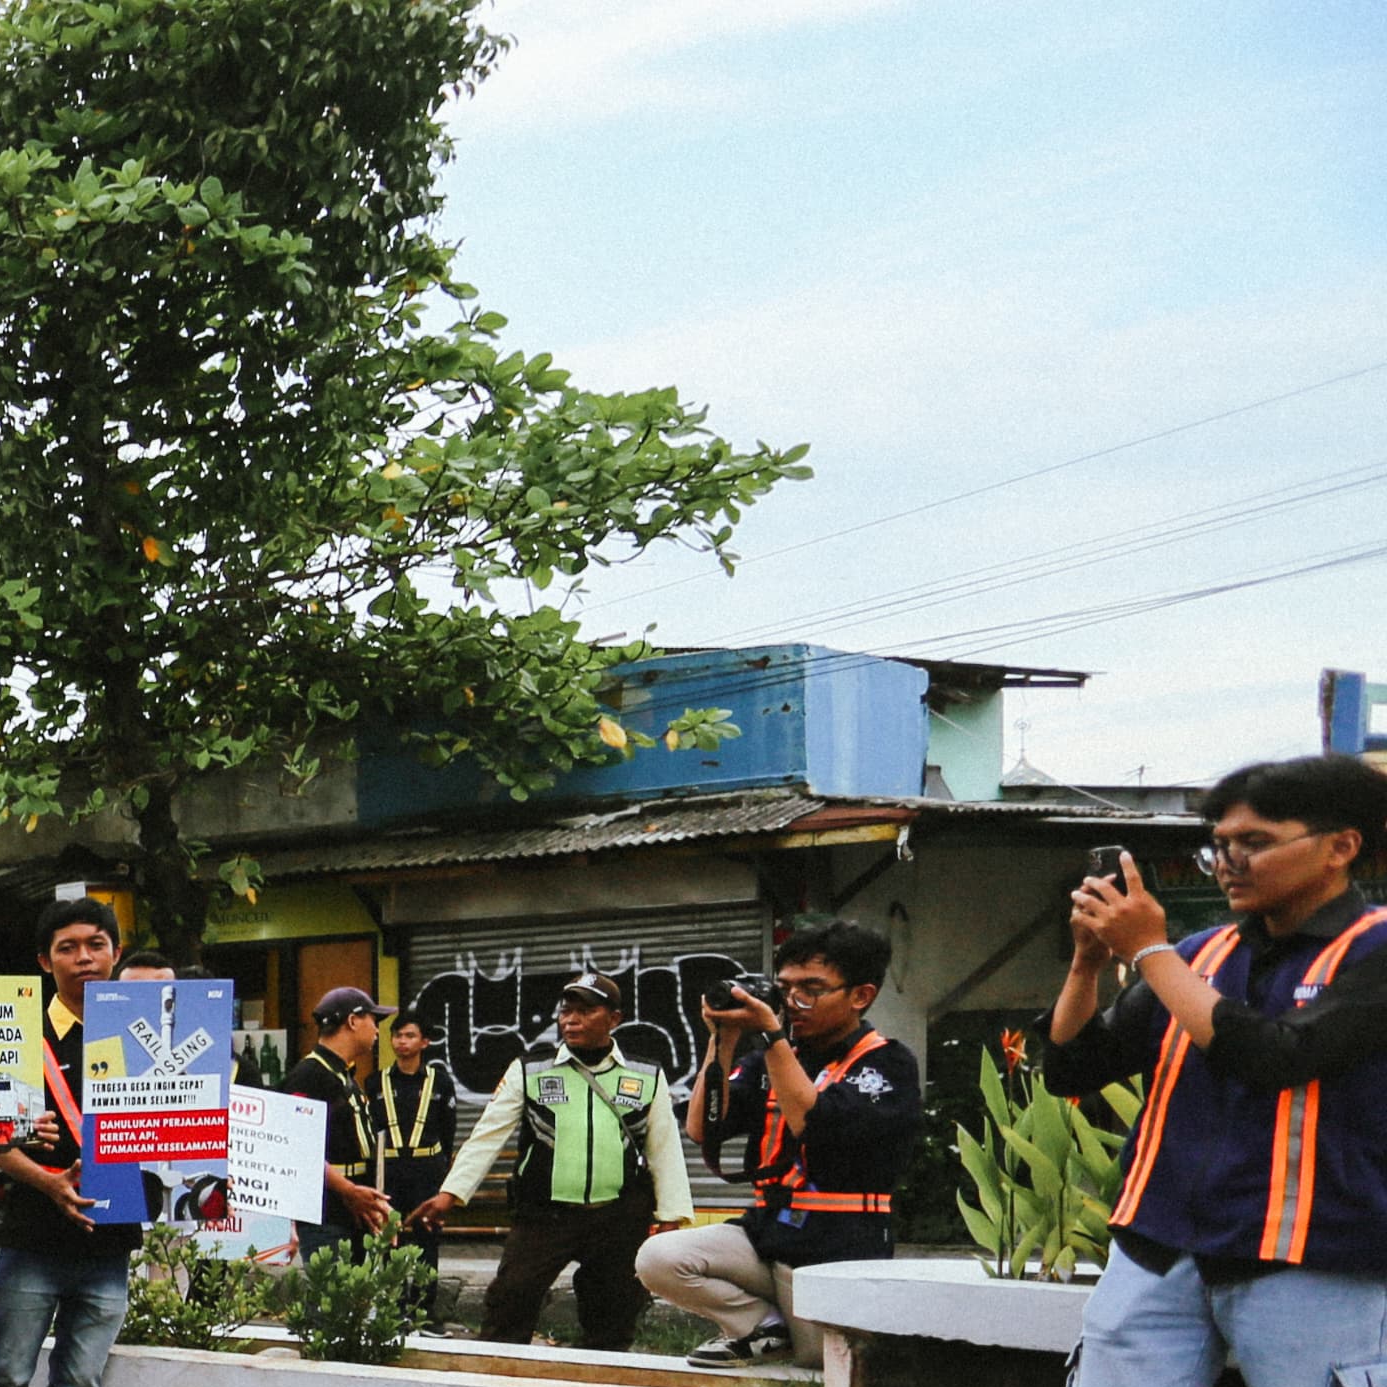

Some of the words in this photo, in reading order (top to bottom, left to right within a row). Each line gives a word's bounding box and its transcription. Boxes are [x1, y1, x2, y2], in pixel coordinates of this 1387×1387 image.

[133, 1021, 163, 1058] RAIL
[0, 1050, 18, 1065] API
[131, 1082, 150, 1091] GESA
[180, 1080, 204, 1090] CEPAT
[124, 1097, 147, 1106] TIDAK
[231, 1101, 257, 1116] OP
[100, 1118, 160, 1130] DAHULUKAN
[163, 1116, 225, 1128] PERJALANAN
[100, 1131, 136, 1141] KERETA
[230, 1127, 289, 1144] ENEROBOS
[100, 1144, 155, 1154] UTAMAKAN
[157, 1141, 226, 1152] KESELAMATAN
[237, 1159, 276, 1173] KERETA
[280, 1168, 297, 1177] API
[228, 1191, 278, 1210] AMU!!
